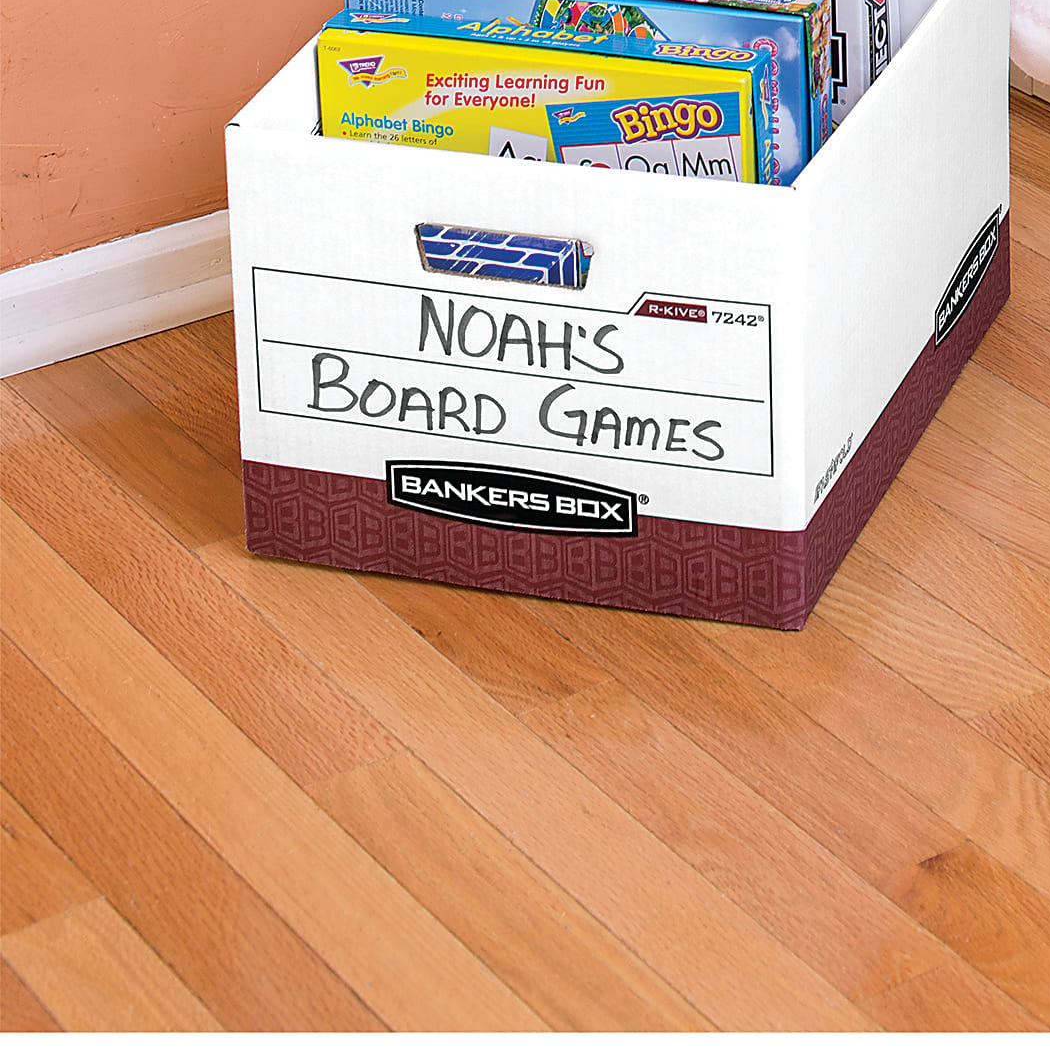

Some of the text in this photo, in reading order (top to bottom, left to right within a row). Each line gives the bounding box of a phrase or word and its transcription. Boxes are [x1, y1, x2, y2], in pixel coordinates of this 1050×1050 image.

[456, 19, 753, 61] Alphabet Bingo
[424, 91, 536, 111] for Everyone!
[426, 73, 606, 95] Exciting Learning Fun
[341, 111, 455, 138] Alphabet Bingo
[349, 129, 372, 139] Learn
[374, 131, 388, 140] the
[389, 133, 400, 142] 26
[401, 135, 427, 145] letters
[428, 137, 438, 146] of
[614, 102, 719, 142] Bingo
[682, 151, 733, 177] Mm
[938, 225, 999, 332] BANKERS BOX
[419, 294, 625, 375] NOAH'S
[307, 351, 507, 435] BOARD
[401, 475, 624, 523] BANKERS BOX
